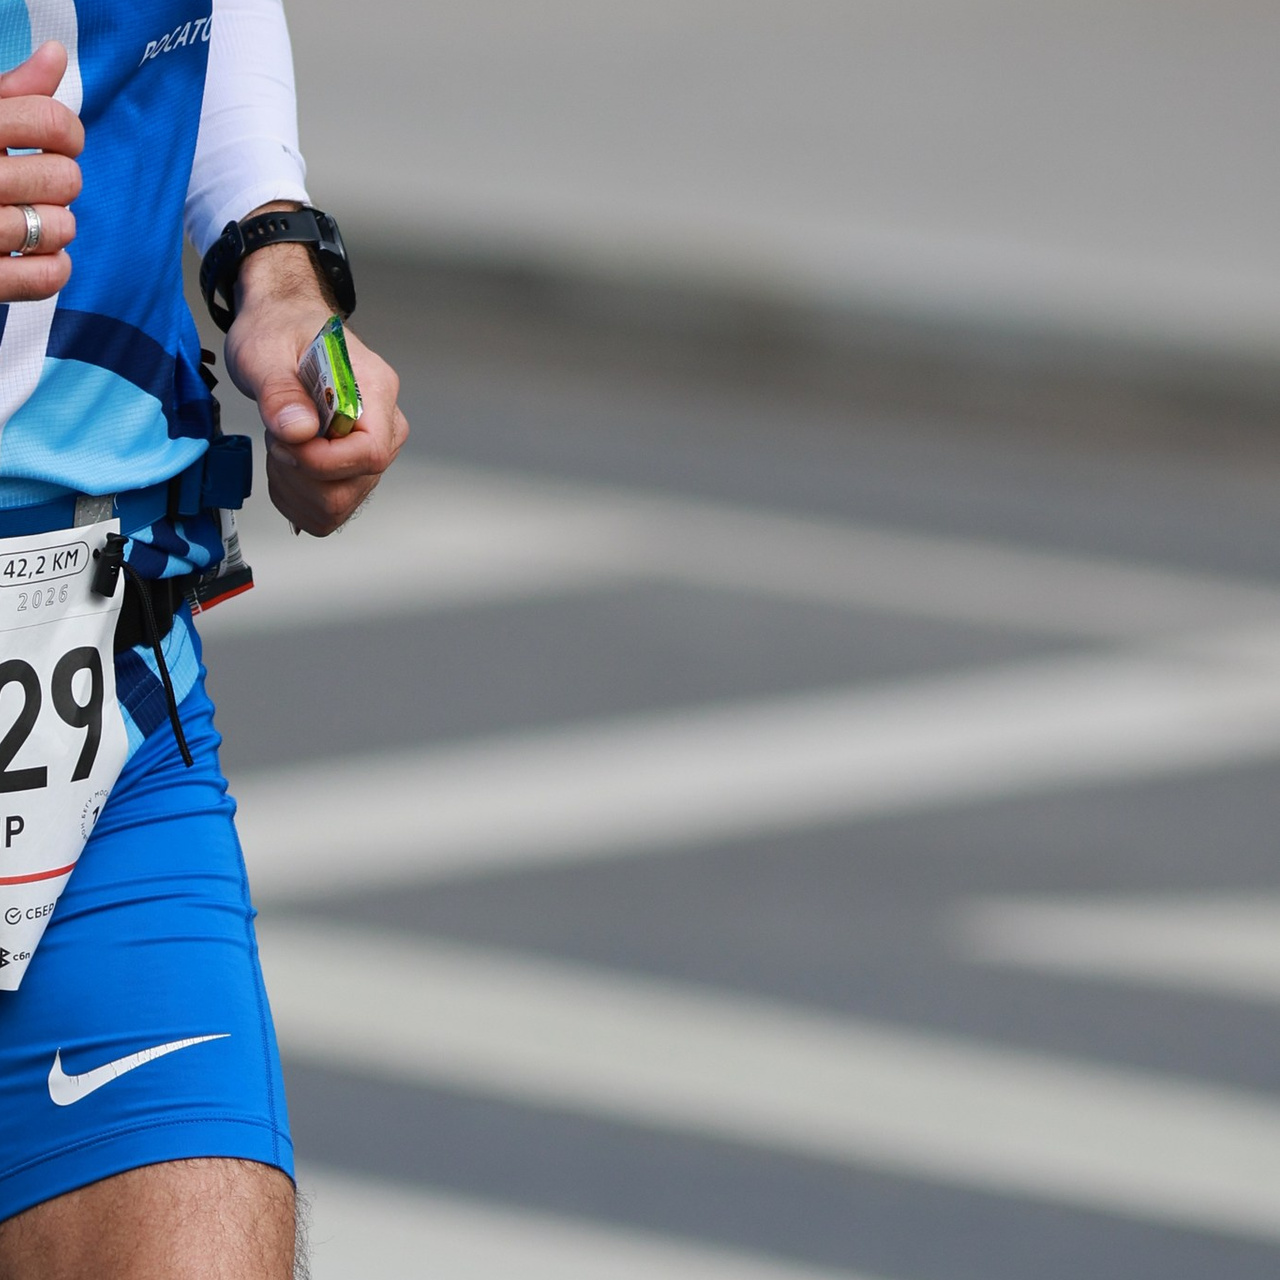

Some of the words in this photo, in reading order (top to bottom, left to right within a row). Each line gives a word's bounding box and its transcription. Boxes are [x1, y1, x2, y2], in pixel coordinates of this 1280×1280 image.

[3, 556, 46, 580] 42,2
[52, 548, 79, 571] КМ
[17, 584, 69, 612] 2026
